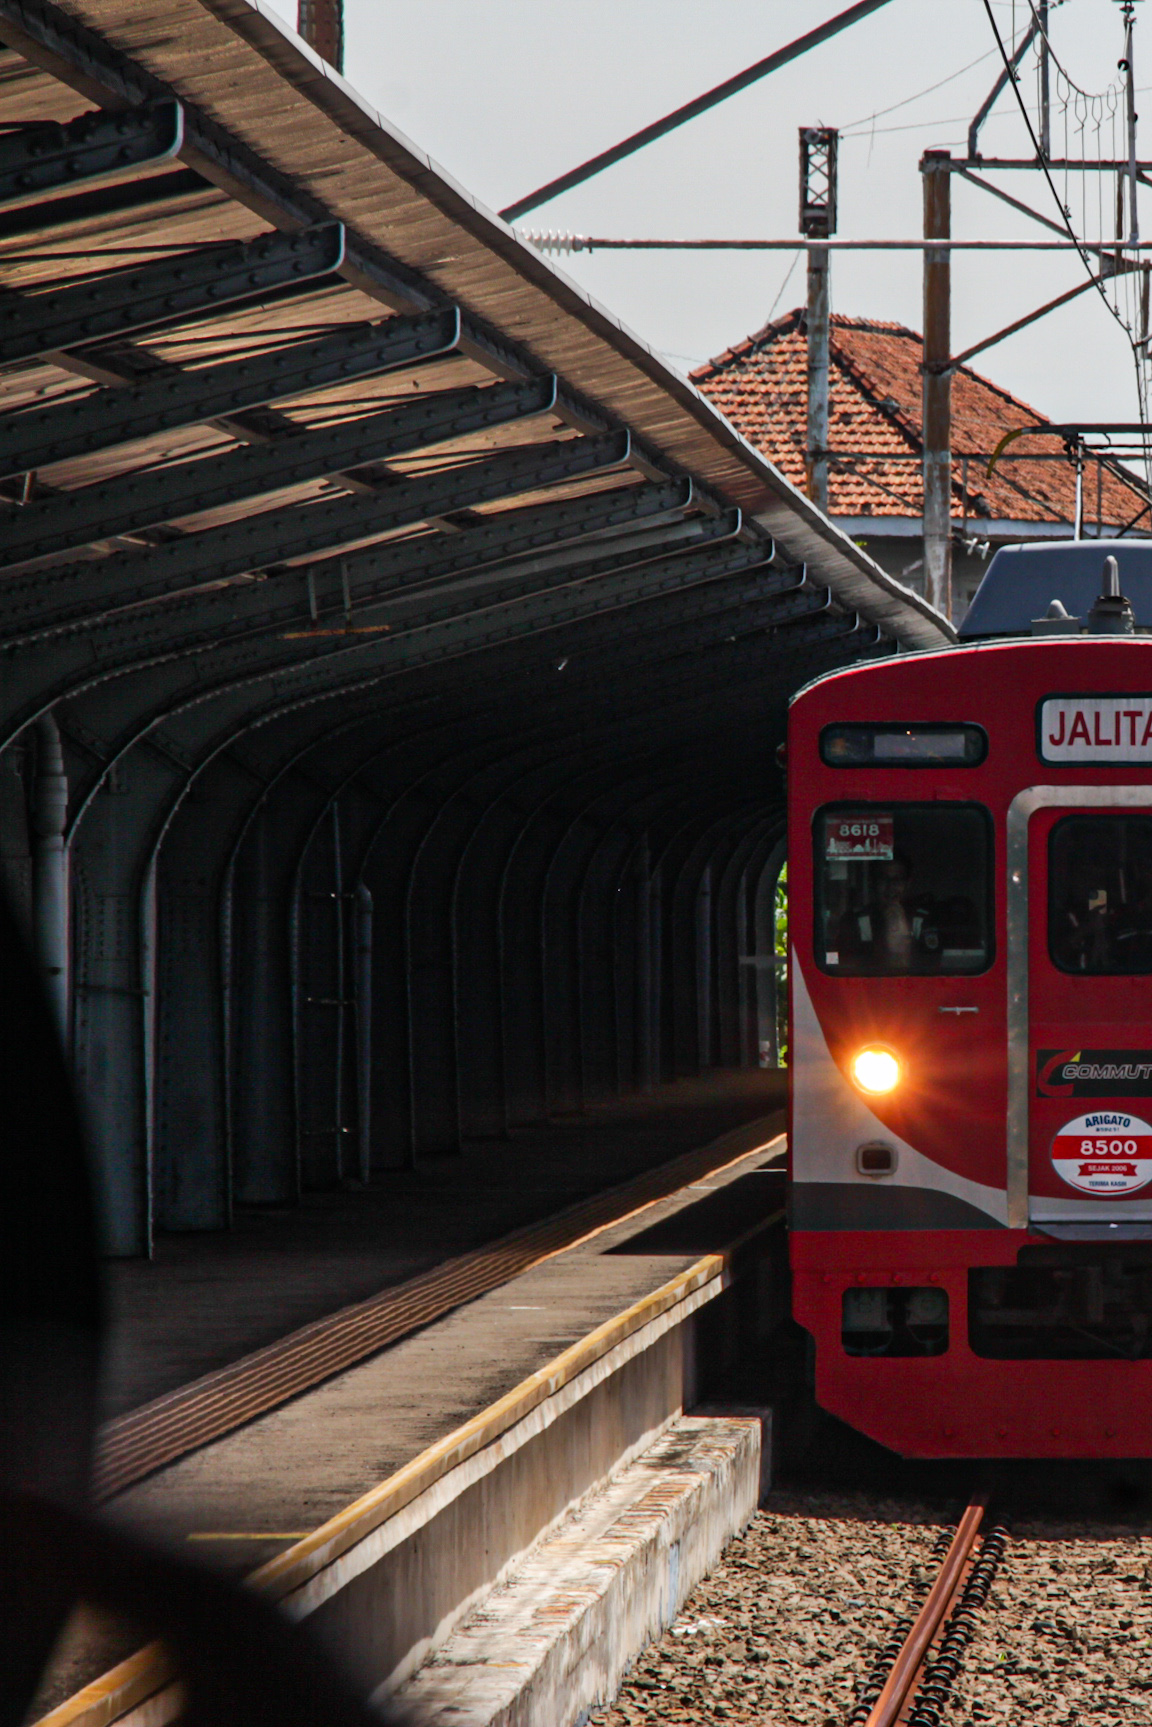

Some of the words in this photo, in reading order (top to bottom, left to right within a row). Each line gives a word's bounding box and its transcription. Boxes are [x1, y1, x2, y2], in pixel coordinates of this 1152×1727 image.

[839, 823, 880, 837] 8618
[1085, 1114, 1131, 1128] ARIGATO
[1080, 1139, 1138, 1155] 8500
